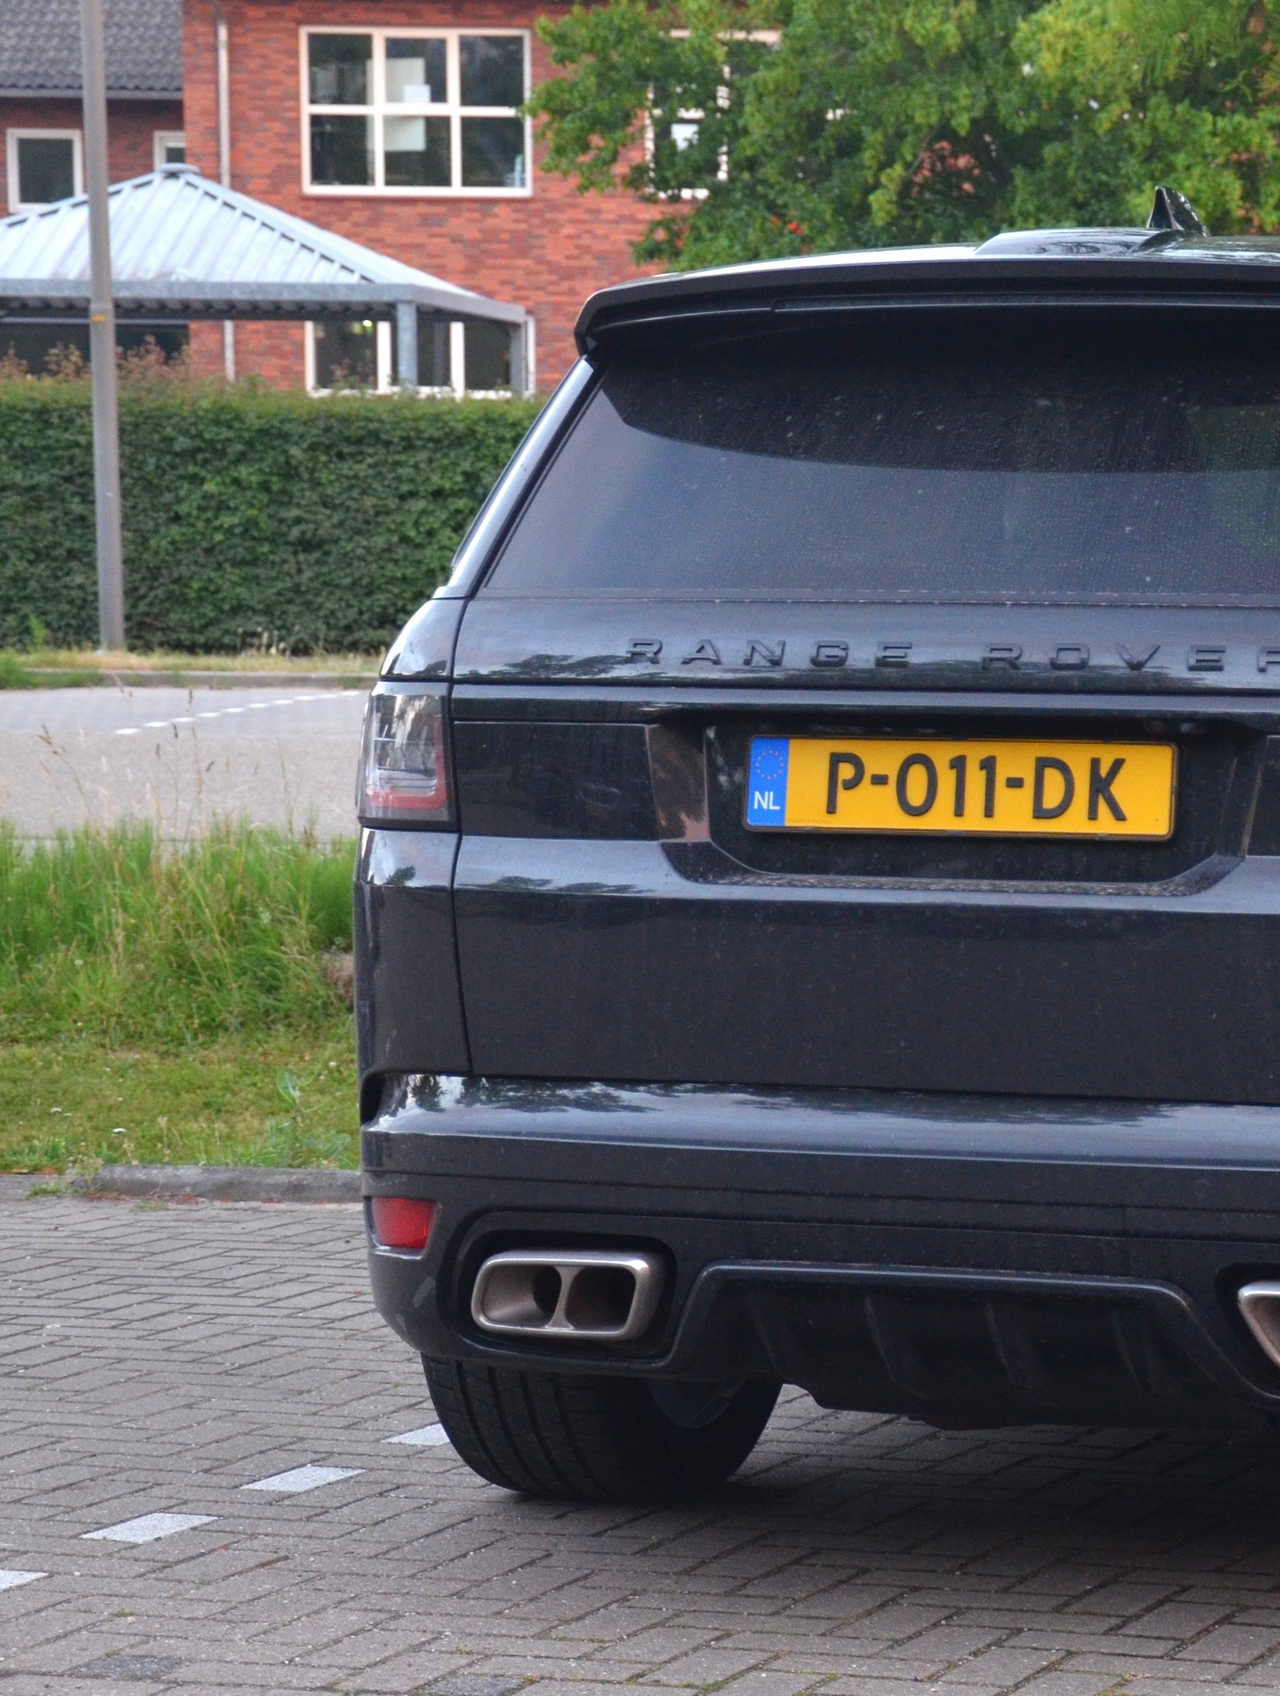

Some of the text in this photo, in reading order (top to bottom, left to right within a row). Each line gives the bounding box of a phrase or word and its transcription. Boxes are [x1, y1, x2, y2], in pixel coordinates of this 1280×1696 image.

[625, 637, 913, 671] RANGE
[753, 790, 780, 810] NL
[826, 751, 1127, 822] P-011-DK
